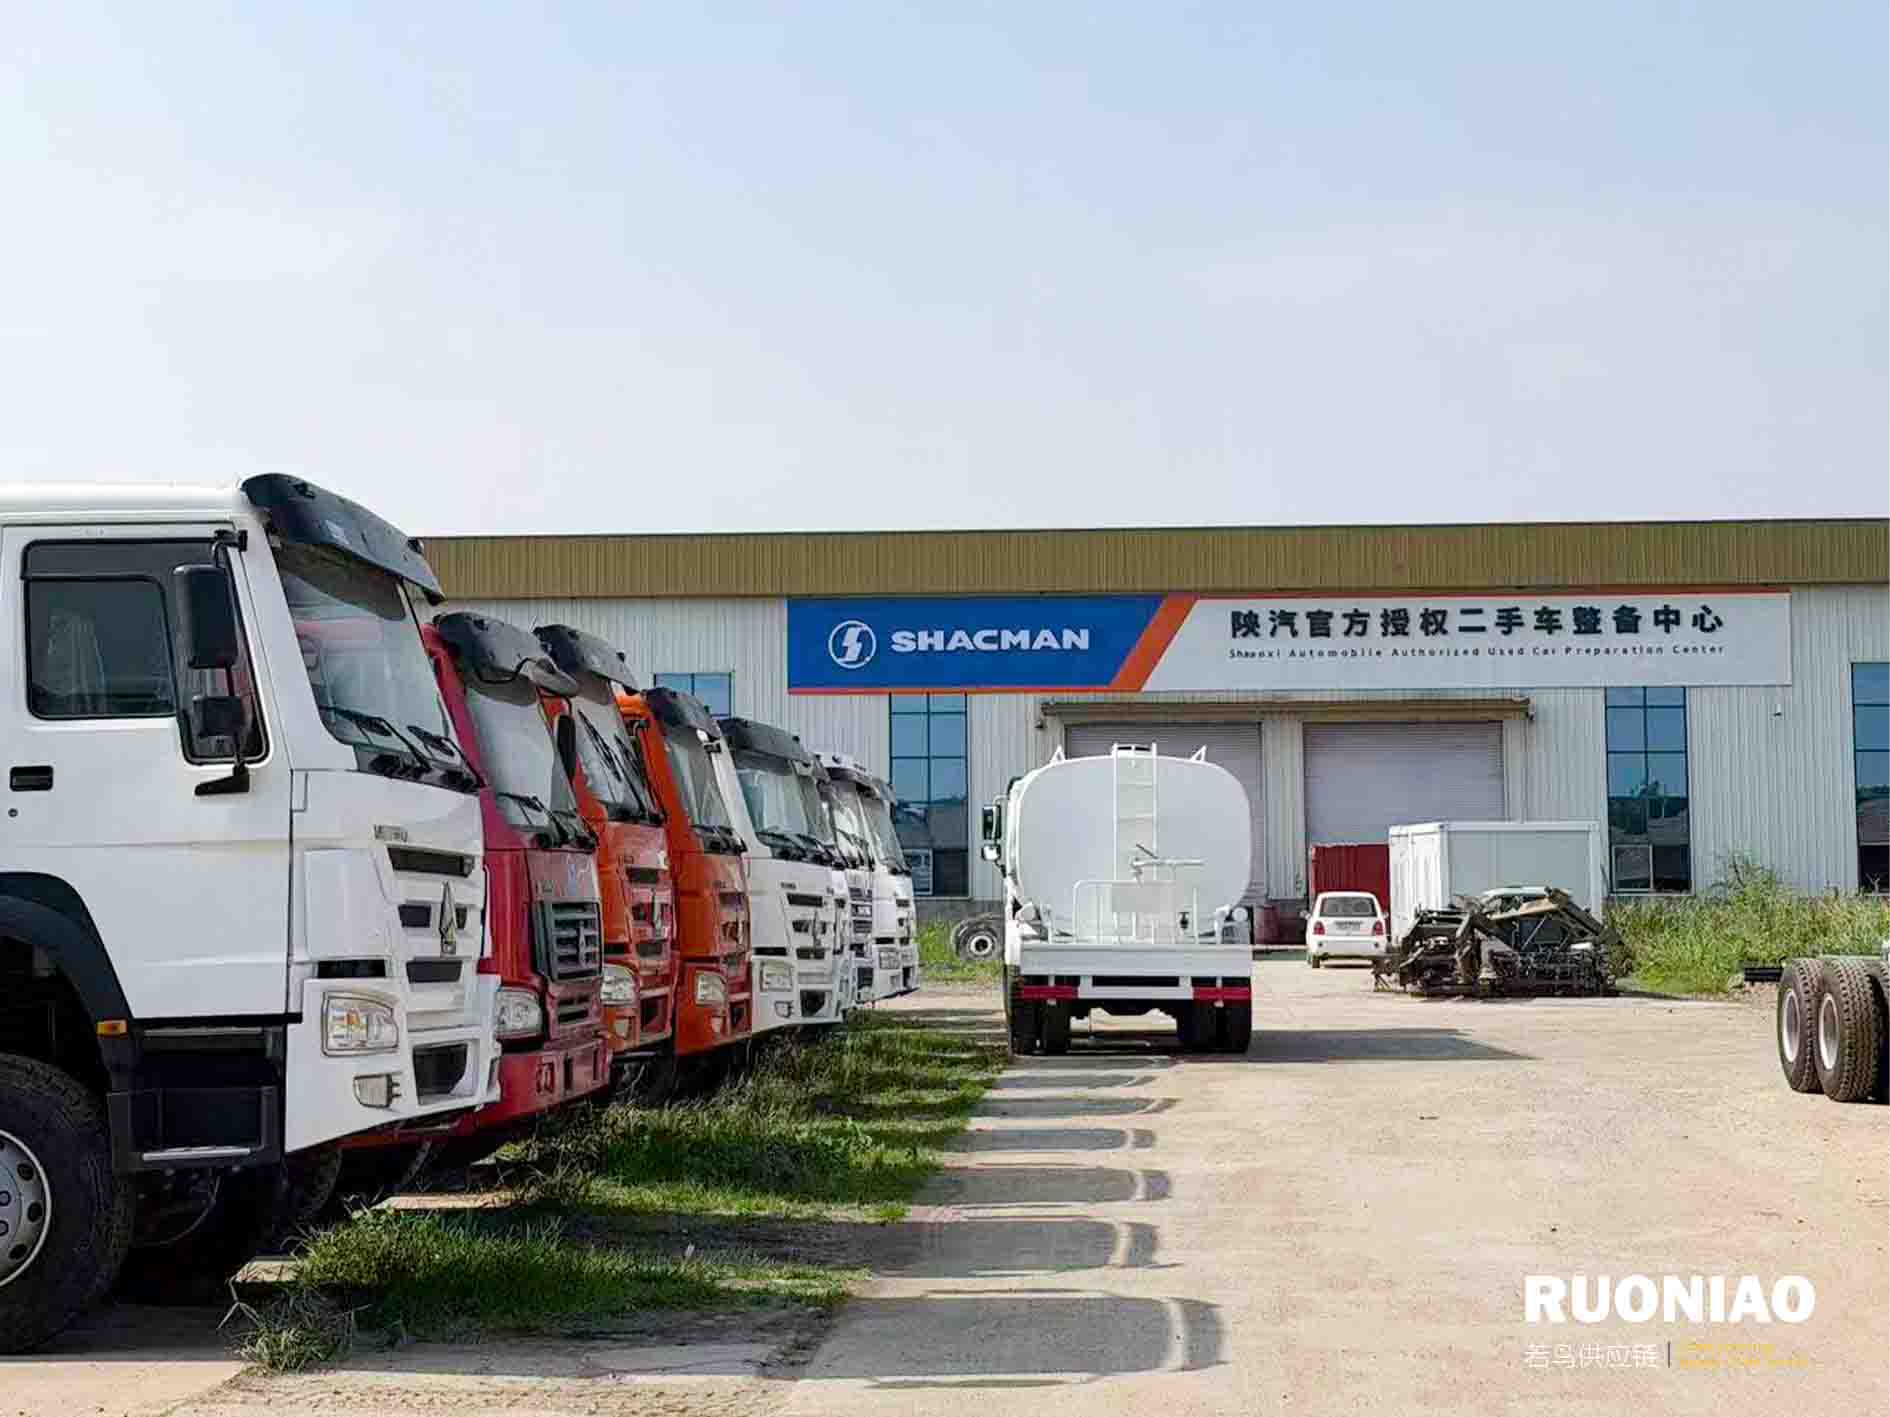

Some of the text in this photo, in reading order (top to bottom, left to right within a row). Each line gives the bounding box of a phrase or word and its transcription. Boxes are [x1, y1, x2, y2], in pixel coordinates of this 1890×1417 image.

[1231, 605, 1724, 638] 陕汽官方授权二手车整备中心
[891, 628, 1090, 653] SHACMAN
[1289, 647, 1382, 657] Automobile
[1392, 647, 1480, 657] Authorized
[1488, 647, 1525, 656] Used
[1532, 646, 1557, 656] Car
[1564, 645, 1664, 656] Preparation
[1672, 644, 1725, 654] Center
